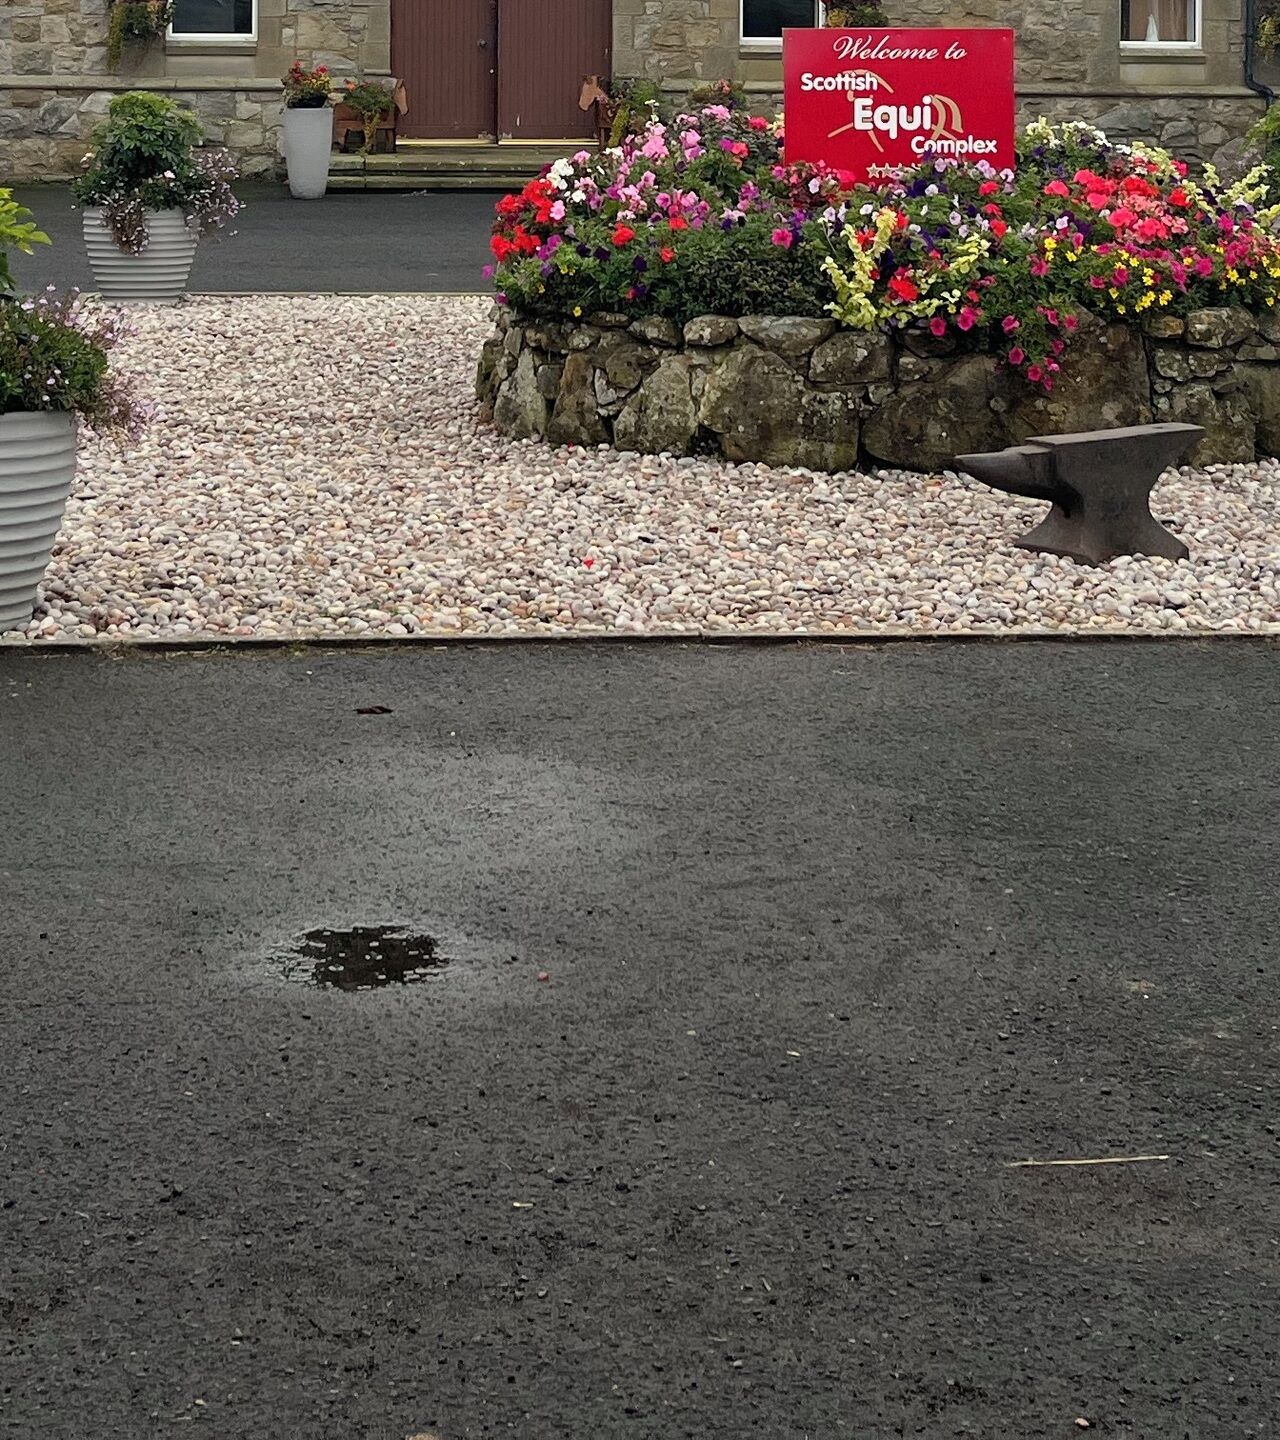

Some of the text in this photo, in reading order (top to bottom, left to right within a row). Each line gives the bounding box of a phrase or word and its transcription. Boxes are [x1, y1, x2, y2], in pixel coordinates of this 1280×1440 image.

[833, 35, 967, 60] Welcome to
[801, 72, 878, 91] Scottish
[854, 96, 931, 139] Equi
[911, 135, 998, 157] Complex
